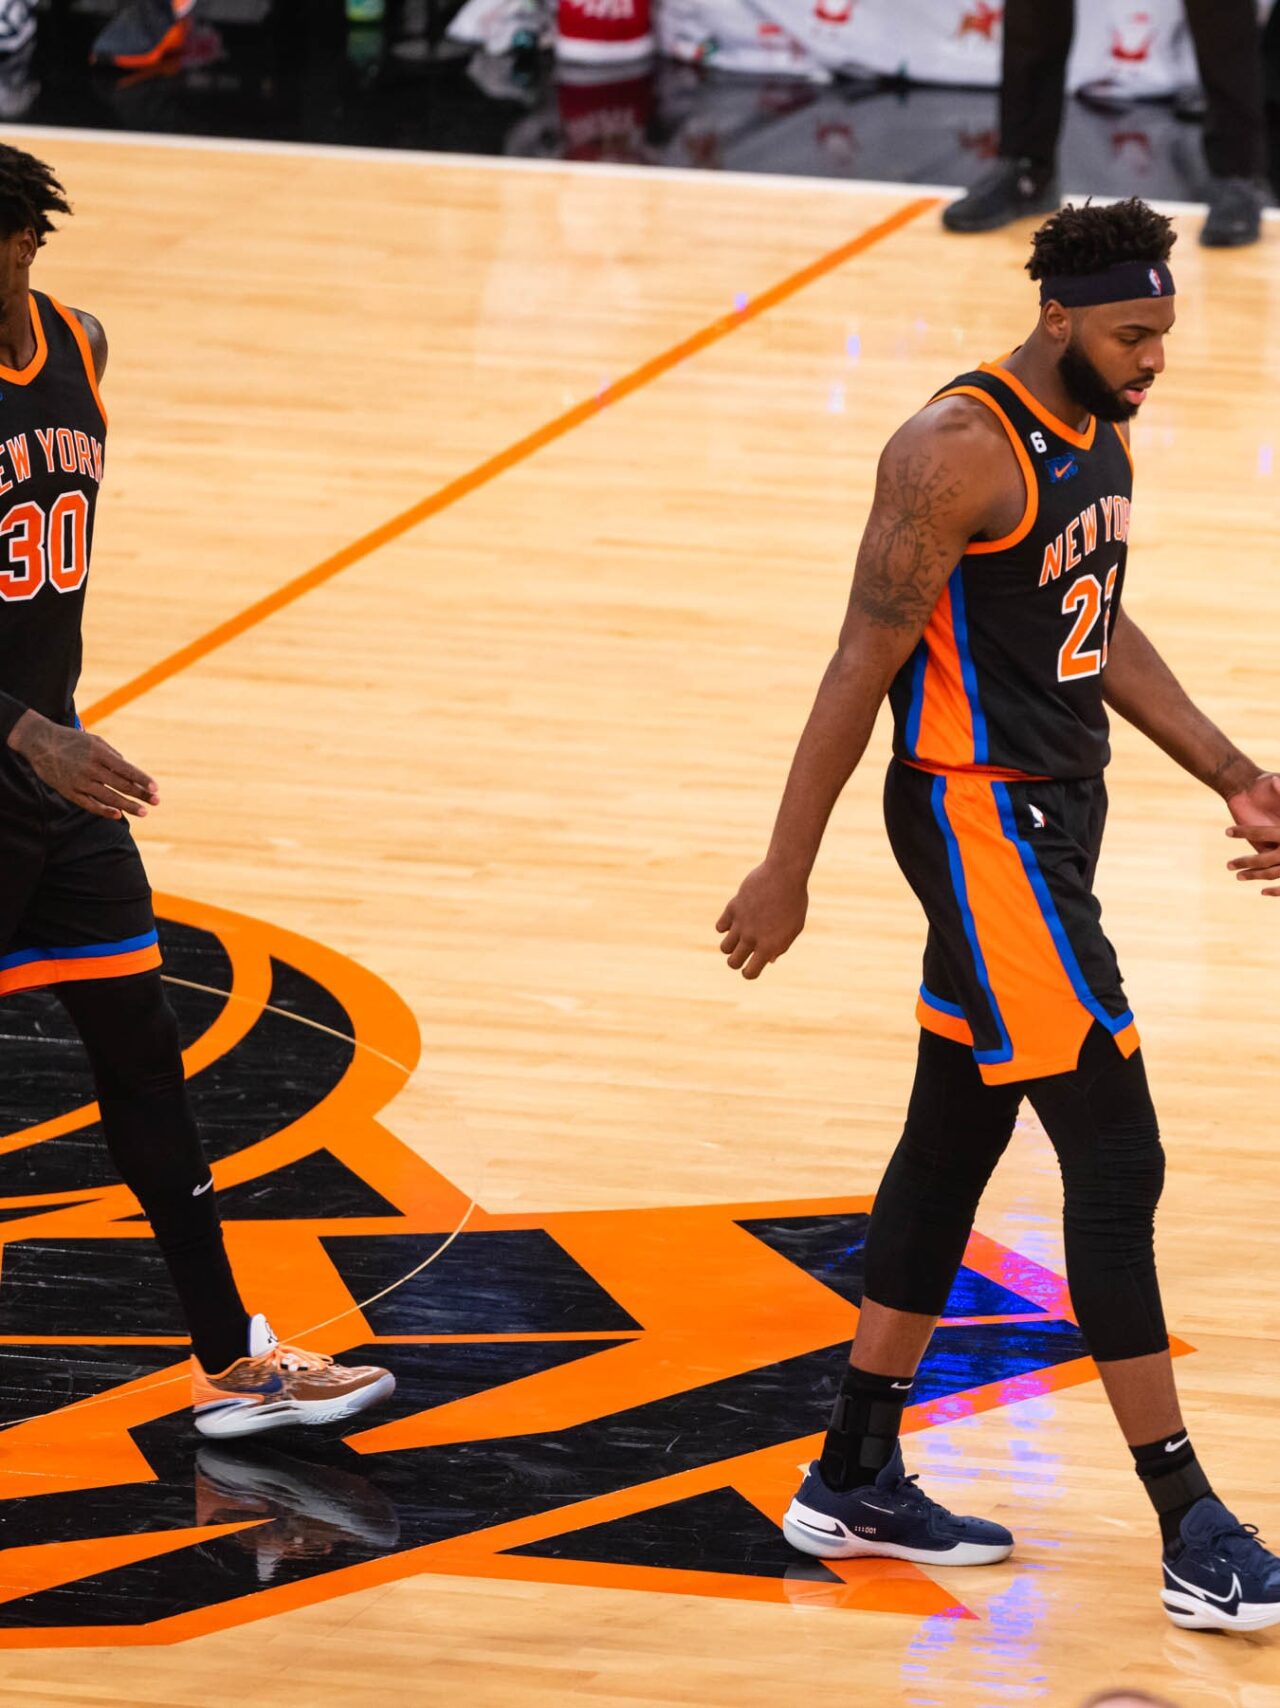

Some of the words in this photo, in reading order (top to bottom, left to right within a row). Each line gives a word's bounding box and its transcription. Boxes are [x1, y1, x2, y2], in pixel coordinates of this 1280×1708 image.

[1030, 431, 1047, 453] 6
[0, 490, 89, 602] 30
[1038, 503, 1097, 587] NEW
